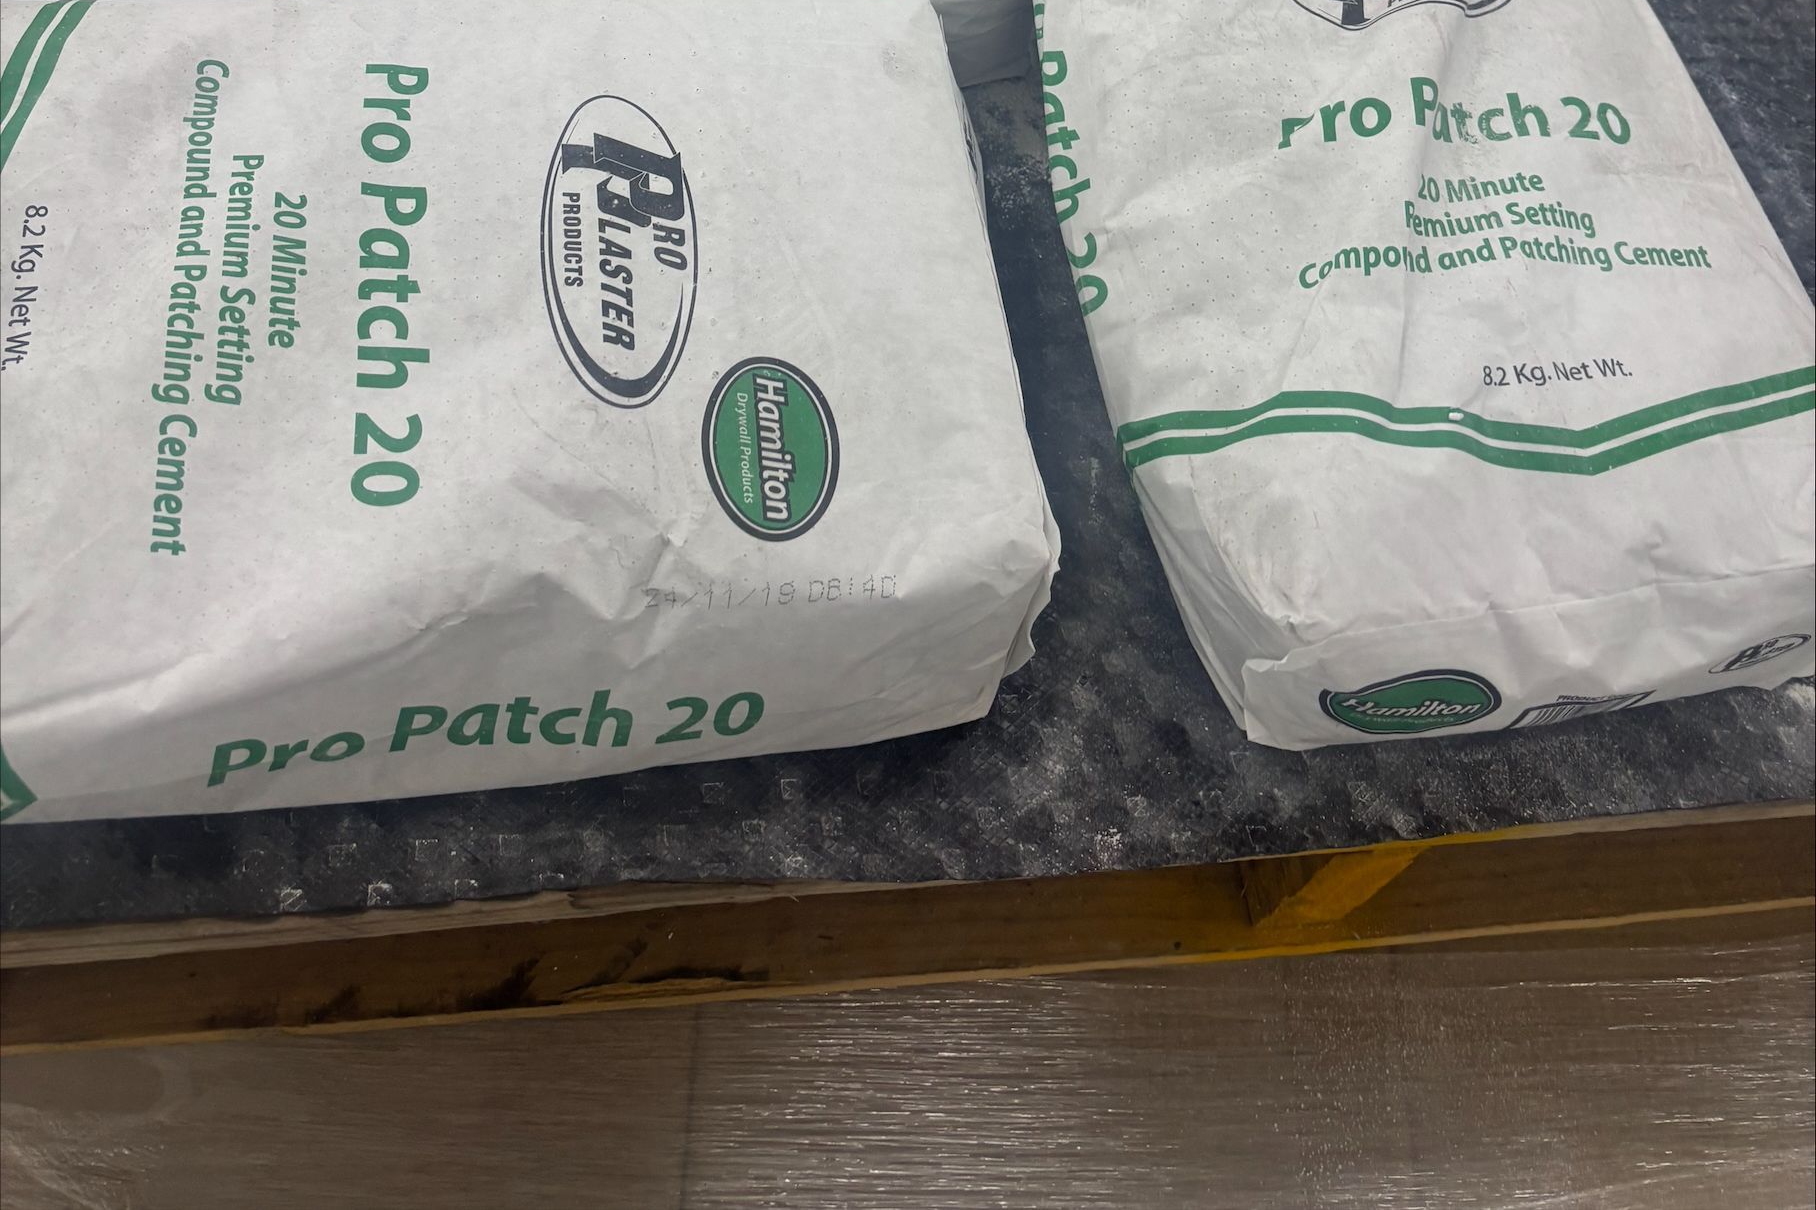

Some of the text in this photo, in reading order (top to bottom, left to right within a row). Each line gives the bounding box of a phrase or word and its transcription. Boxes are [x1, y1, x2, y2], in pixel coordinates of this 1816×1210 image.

[1410, 76, 1552, 144] Patch
[1560, 95, 1632, 146] 20
[1403, 199, 1597, 239] Pemium Setting
[1416, 171, 1546, 204] 20 Minute
[0, 204, 49, 372] 8.2 Kg. Net Wt.
[203, 152, 265, 407] Premium Setting
[268, 190, 308, 350] 20 Minute
[350, 62, 431, 508] Pro Patch 20
[561, 191, 585, 289] PRODUCTS
[1438, 237, 1497, 272] and
[1498, 234, 1614, 272] Patching
[1613, 240, 1713, 269] Cement
[149, 58, 231, 558] Compound and Patching Cement
[1482, 357, 1634, 387] 8.2 Kg. Net Wt.
[736, 391, 756, 505] Drywall Products
[754, 376, 793, 522] Hamilton
[206, 688, 766, 788] Pro Patch 20
[1340, 698, 1482, 717] Hamilton
